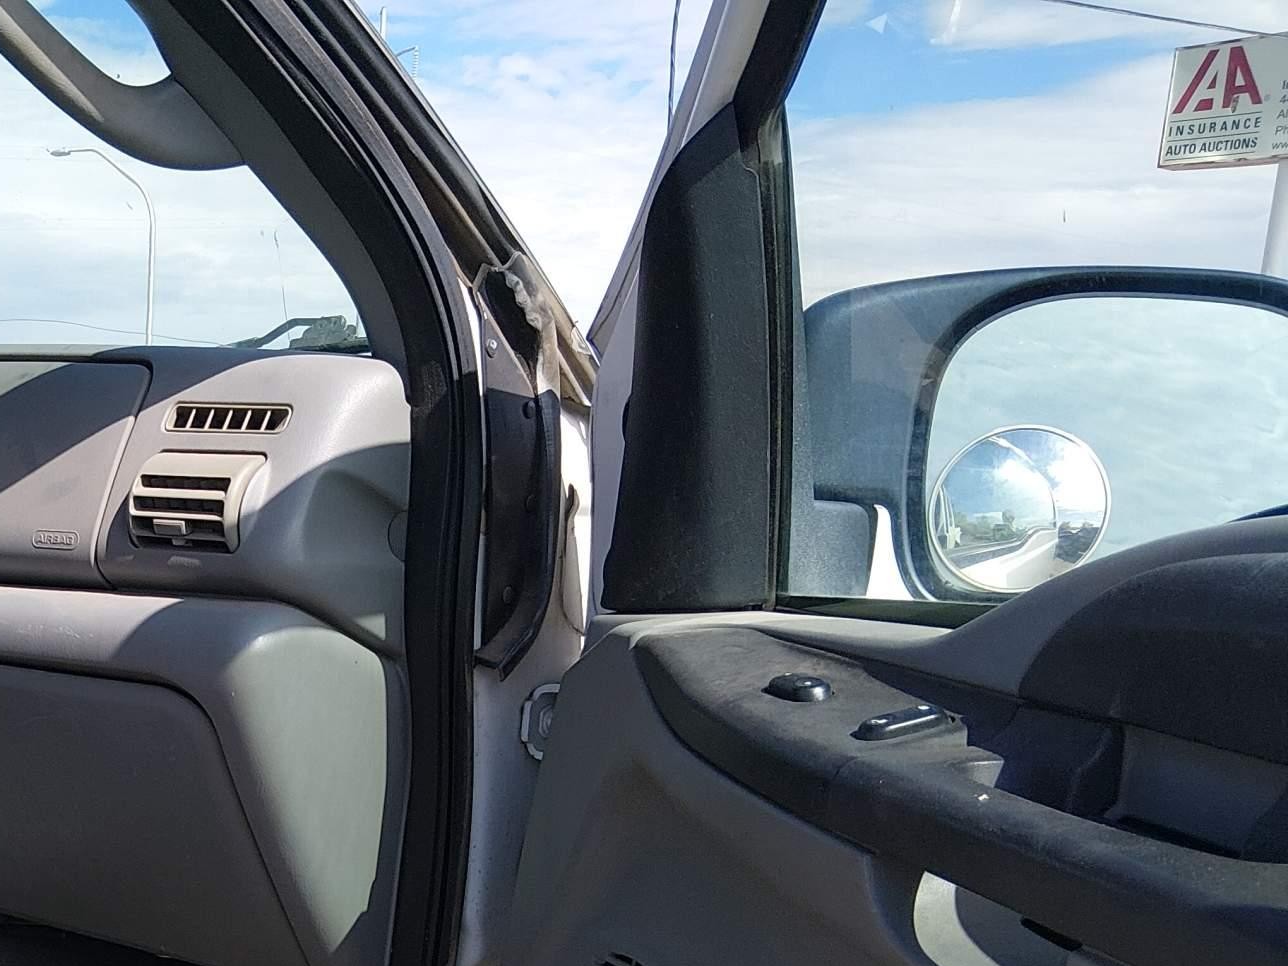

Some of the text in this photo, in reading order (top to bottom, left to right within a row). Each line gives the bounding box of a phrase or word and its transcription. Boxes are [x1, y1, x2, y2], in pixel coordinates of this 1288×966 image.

[1168, 116, 1262, 137] INSURANCE
[1165, 143, 1197, 157] AUTO
[1199, 137, 1258, 153] AUCTIONS
[37, 533, 75, 545] AIRBAG
